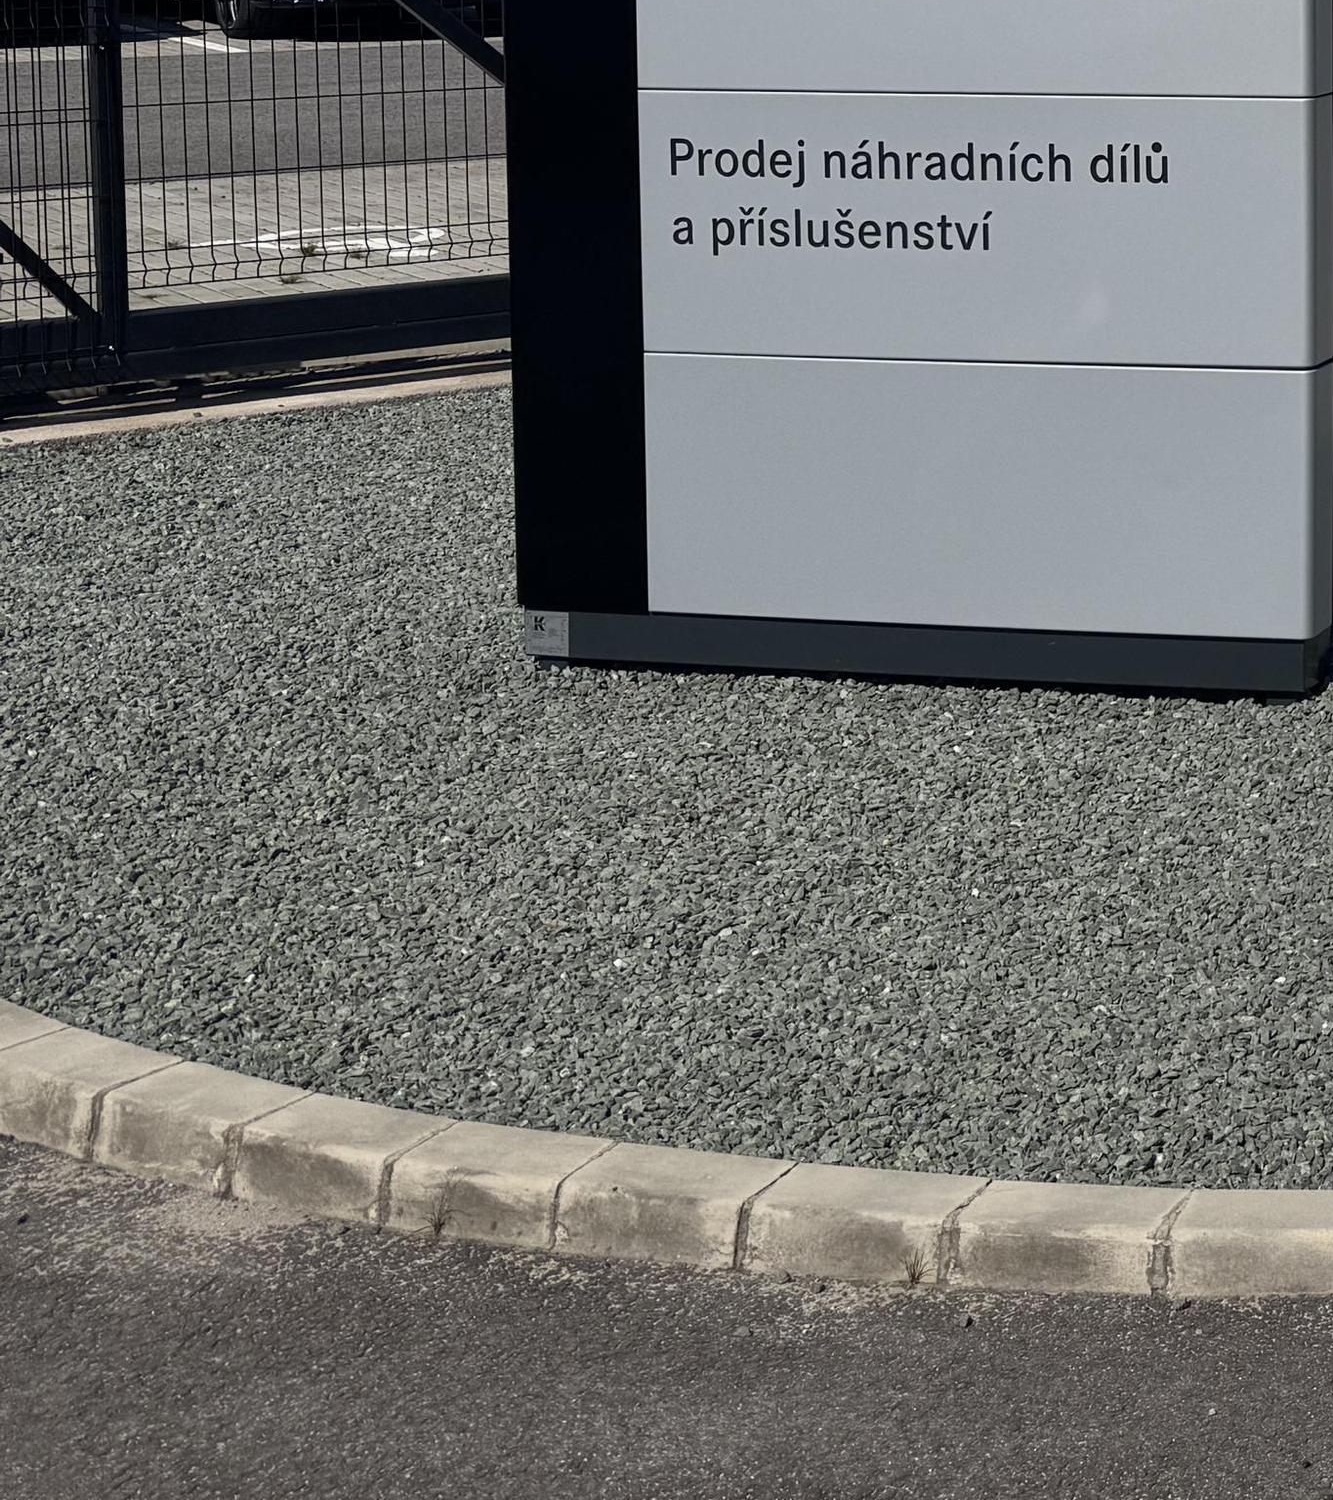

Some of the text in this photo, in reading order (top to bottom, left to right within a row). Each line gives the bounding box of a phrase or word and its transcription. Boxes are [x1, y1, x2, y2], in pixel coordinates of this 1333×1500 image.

[669, 137, 1170, 189] Prodej náhradních dílů
[672, 206, 993, 257] a příslušenství
